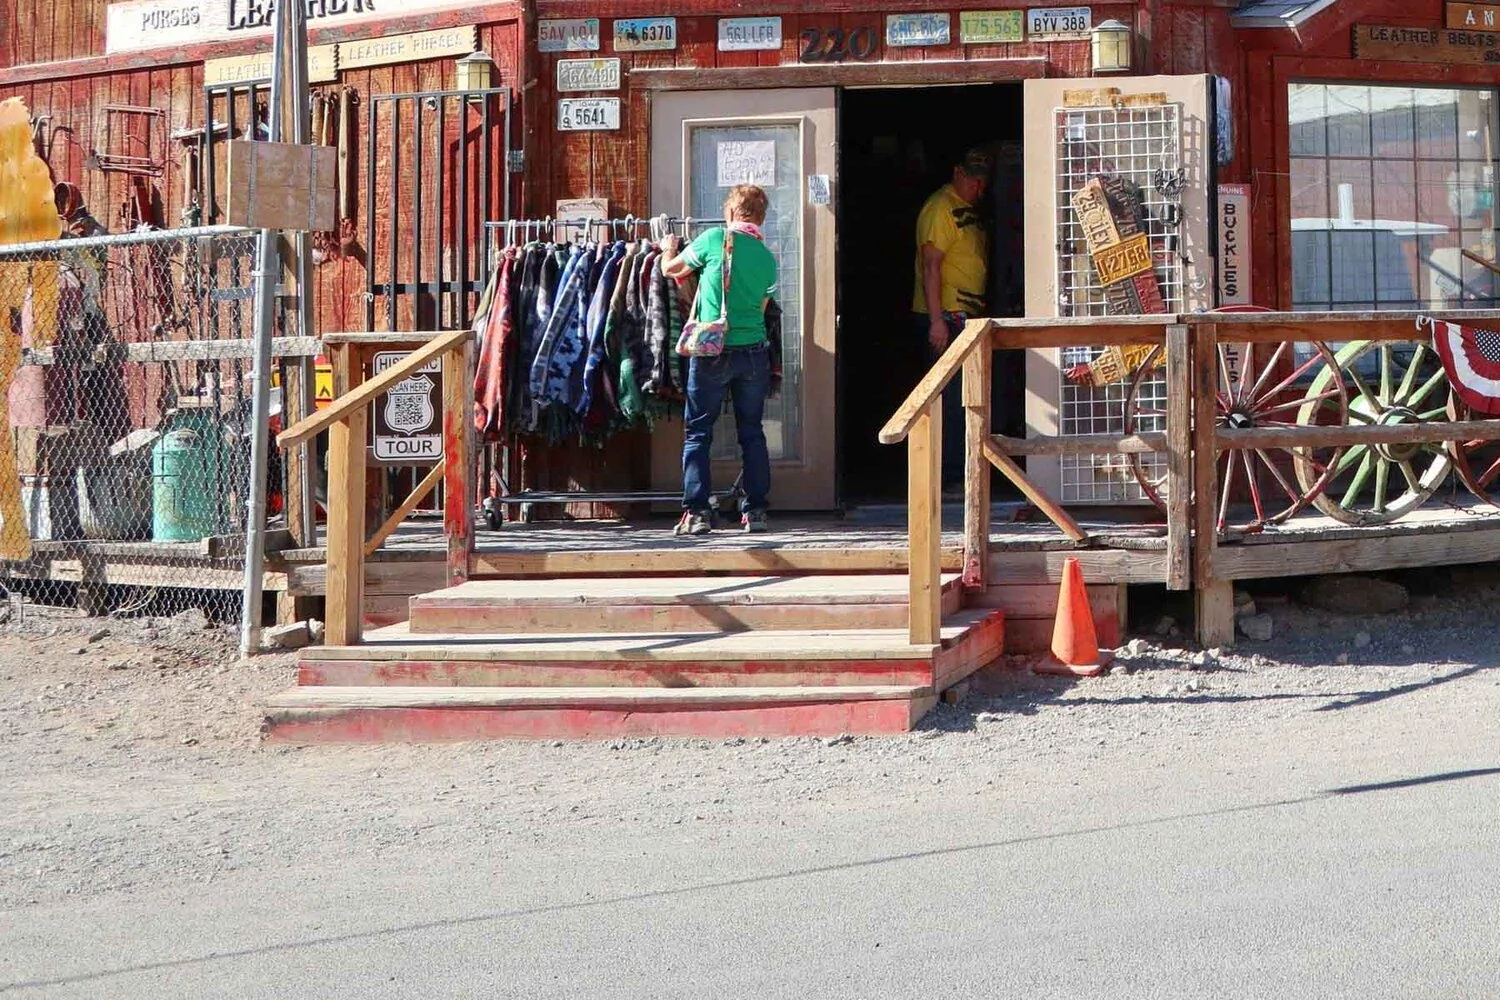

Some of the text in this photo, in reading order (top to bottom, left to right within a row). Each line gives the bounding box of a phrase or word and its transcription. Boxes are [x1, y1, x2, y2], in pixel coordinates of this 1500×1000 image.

[142, 5, 201, 31] PURSES
[1034, 16, 1086, 32] BYV 388
[642, 24, 672, 41] 6370
[1369, 27, 1440, 45] LEATHER
[1448, 31, 1495, 47] BELTS
[349, 41, 405, 61] LEATHER
[800, 27, 877, 63] 220
[575, 107, 606, 125] 5641
[1224, 203, 1237, 297] BUCKLES
[410, 381, 428, 392] HERE
[385, 440, 433, 454] TOUR
